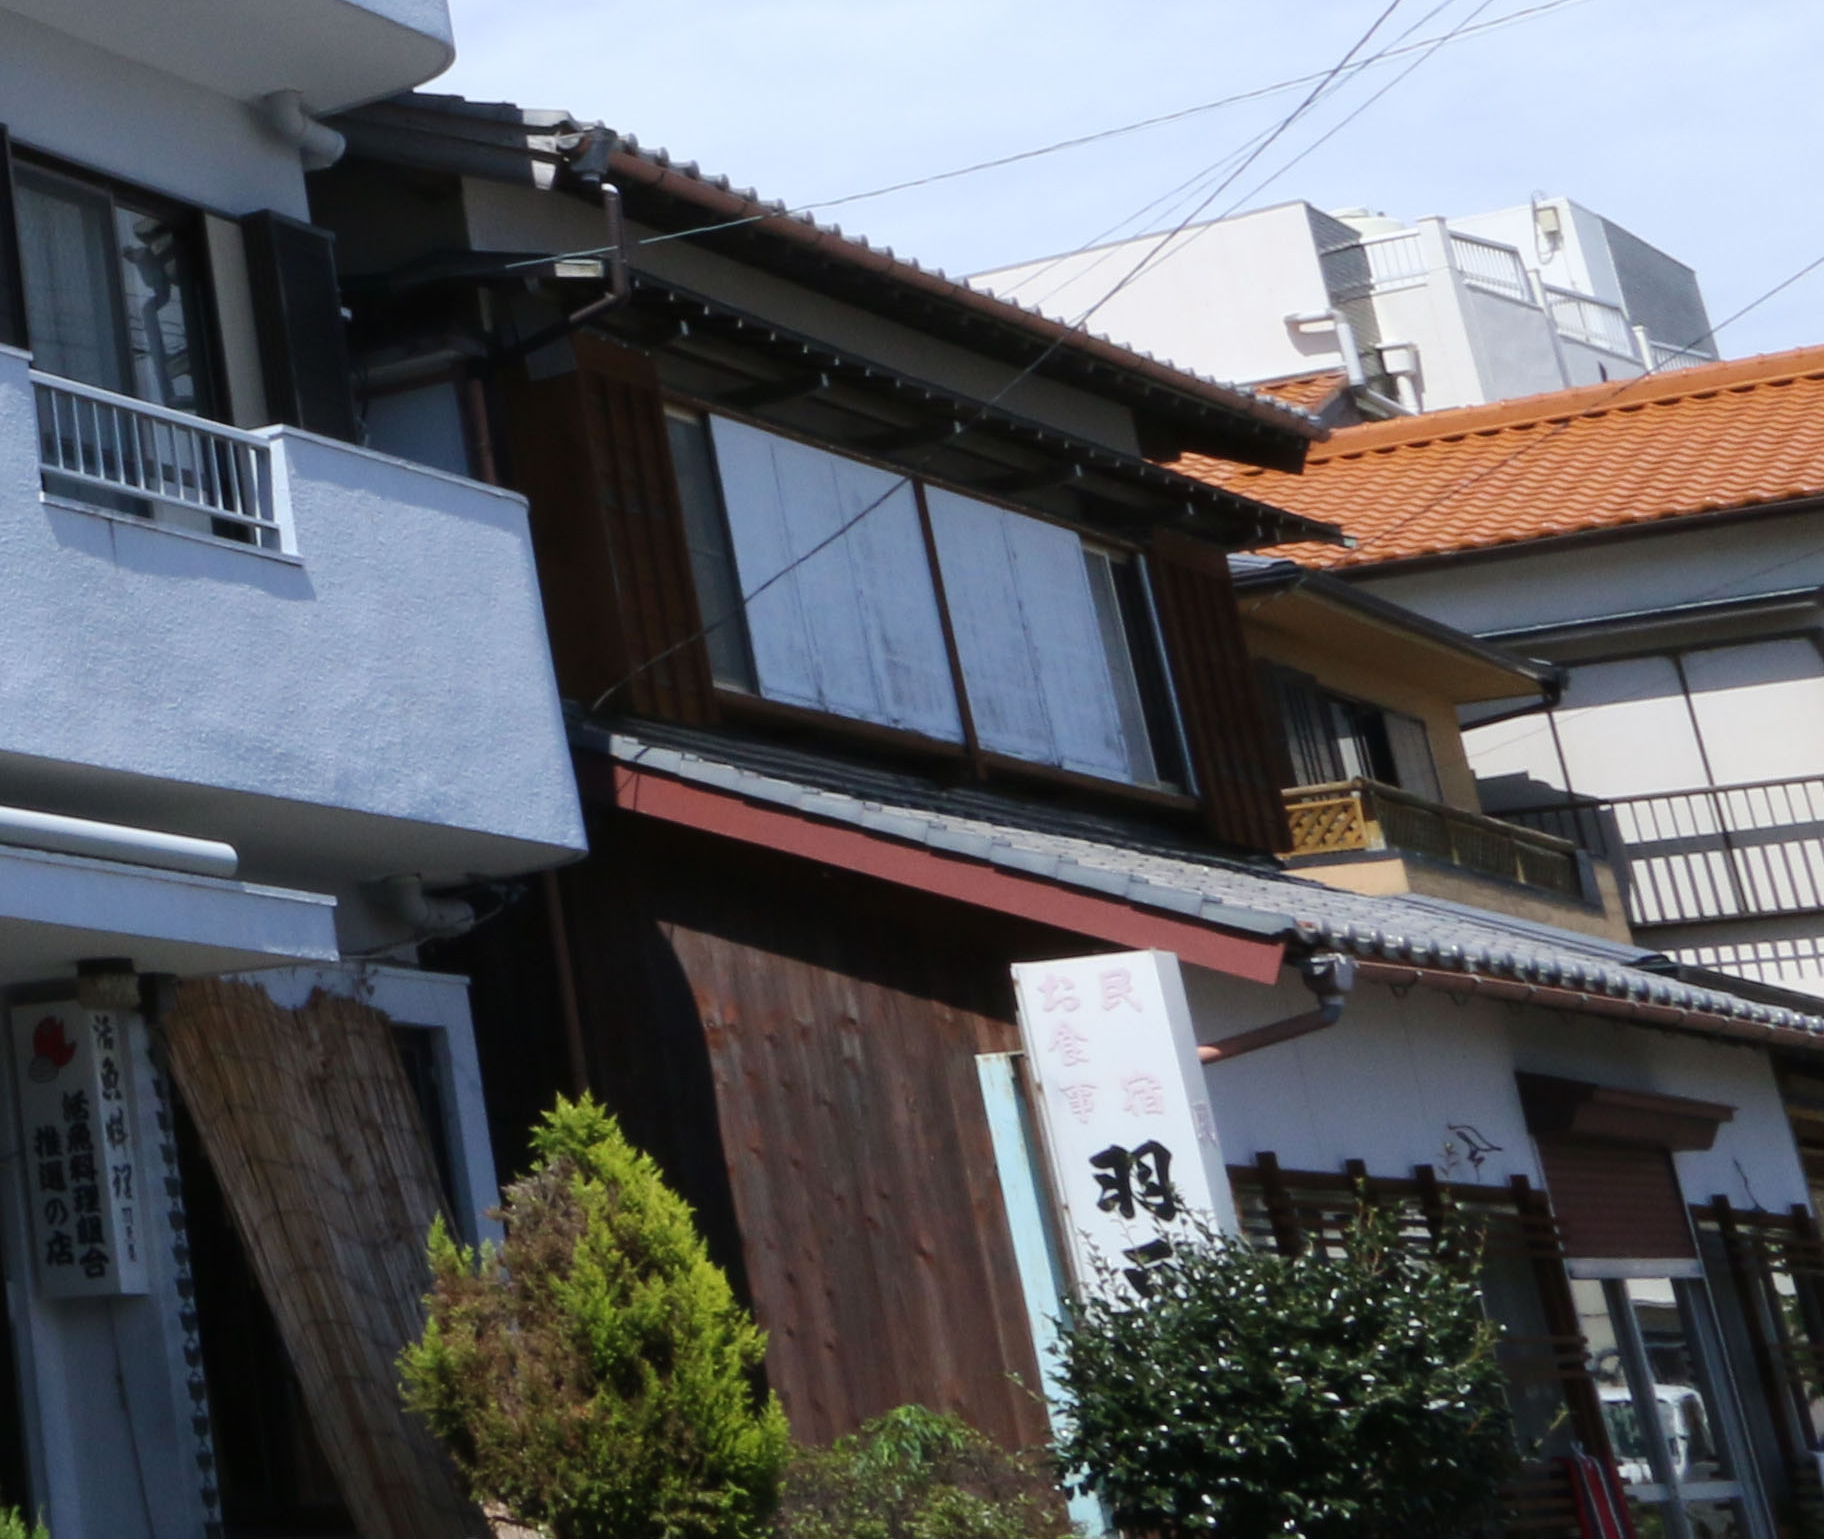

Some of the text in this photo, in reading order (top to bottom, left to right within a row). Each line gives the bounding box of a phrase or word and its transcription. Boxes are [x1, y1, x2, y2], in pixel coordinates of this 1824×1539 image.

[62, 1090, 109, 1279] 活魚料理組合
